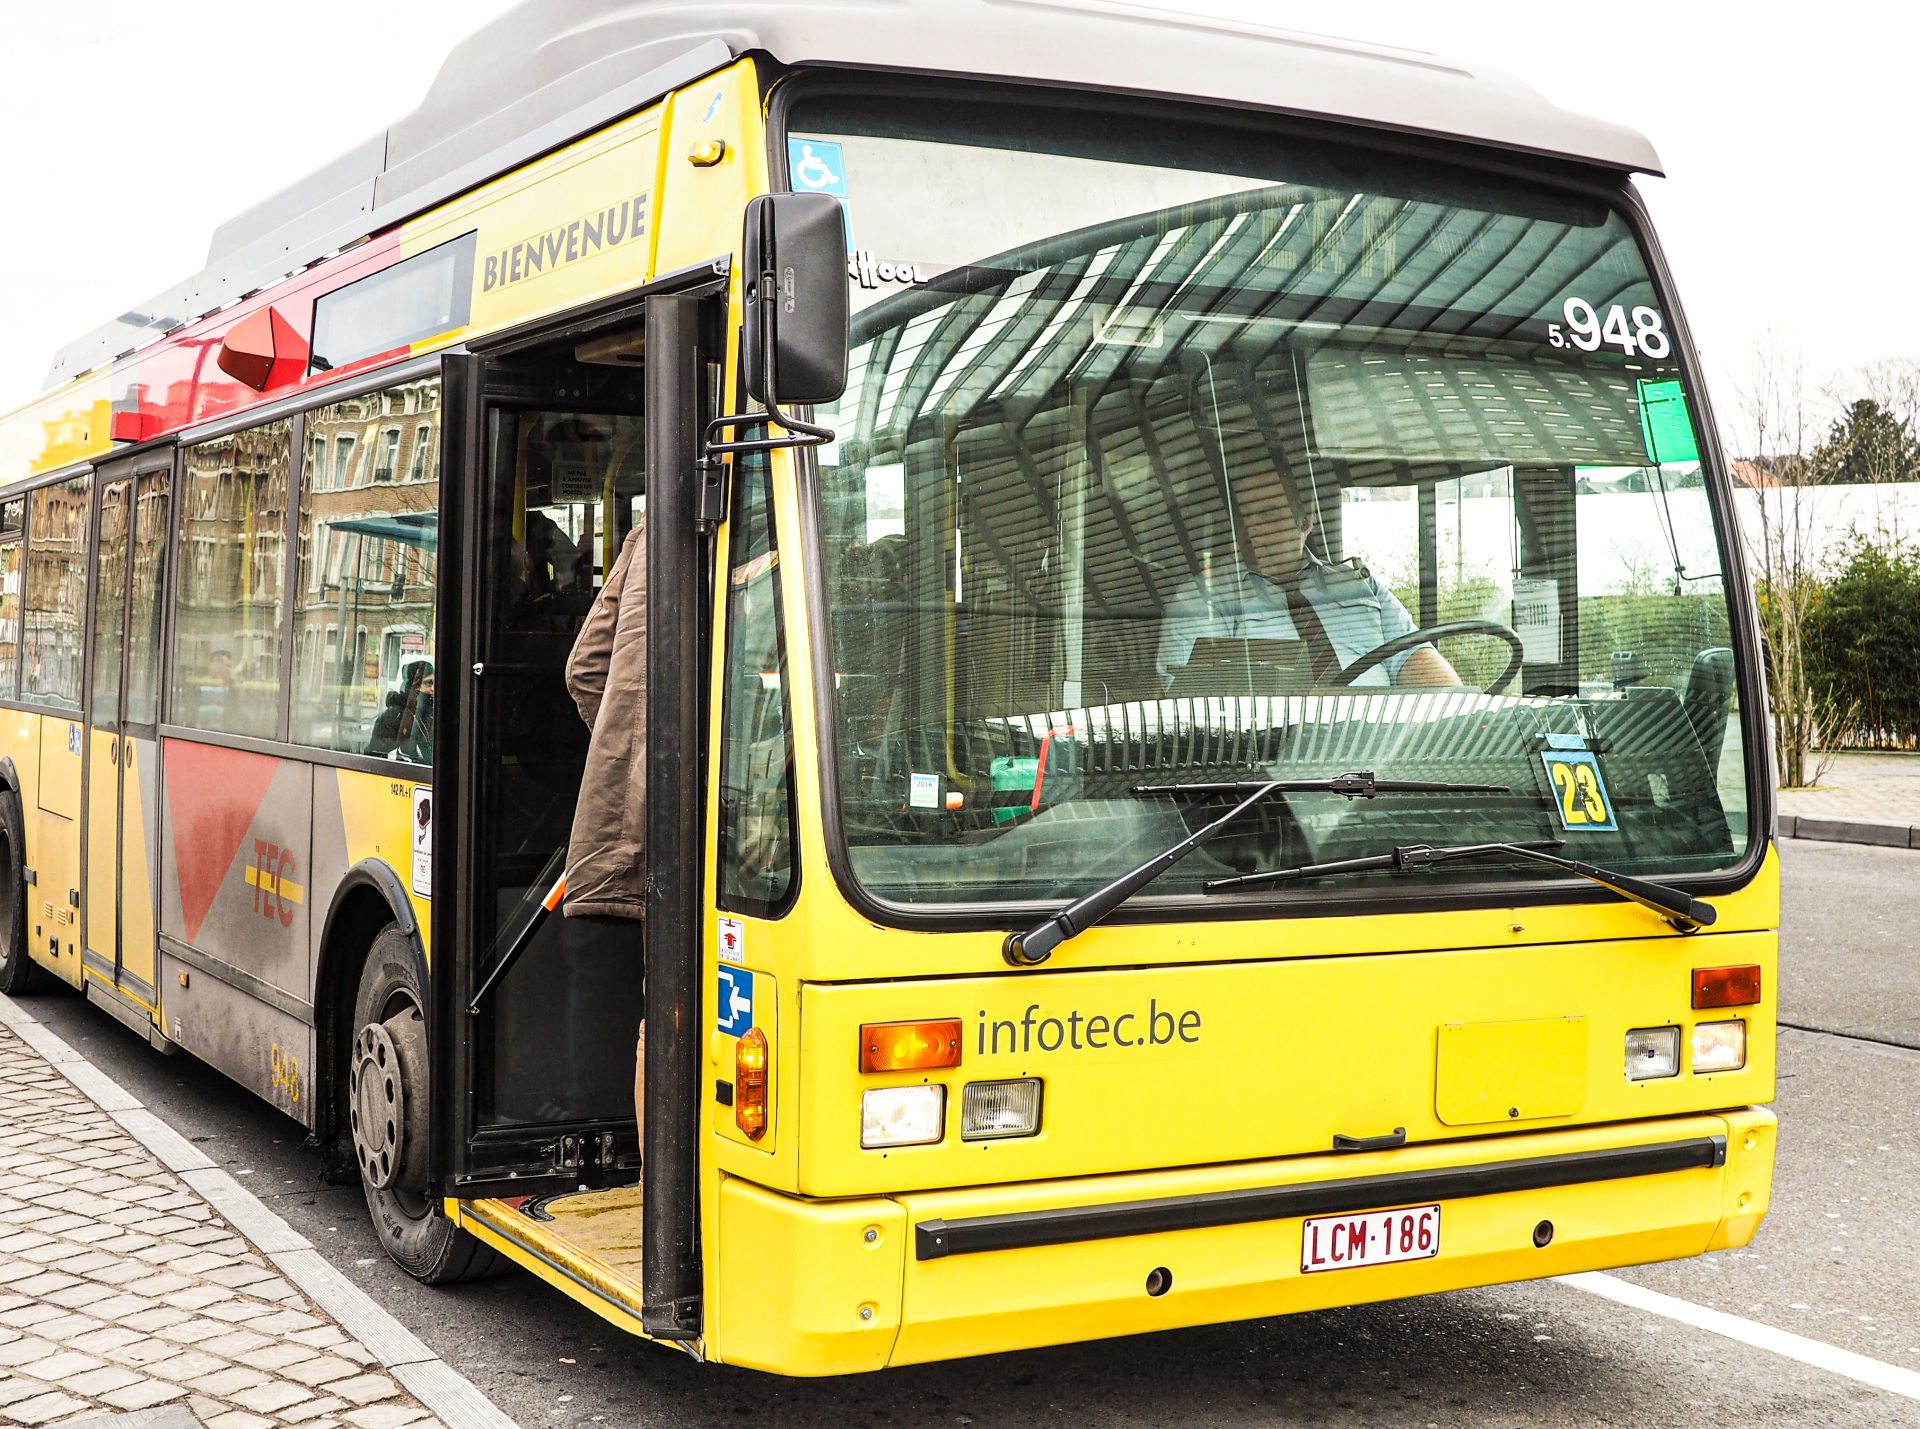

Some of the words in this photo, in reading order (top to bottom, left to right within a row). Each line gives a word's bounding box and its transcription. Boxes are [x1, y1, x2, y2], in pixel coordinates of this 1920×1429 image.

[483, 193, 647, 292] BIENVENUE
[1548, 296, 1670, 359] 5.948
[916, 780, 933, 788] 2016
[1552, 762, 1606, 824] 23
[254, 838, 297, 928] TEC
[978, 998, 1202, 1055] infotec.be
[271, 1042, 299, 1102] 948
